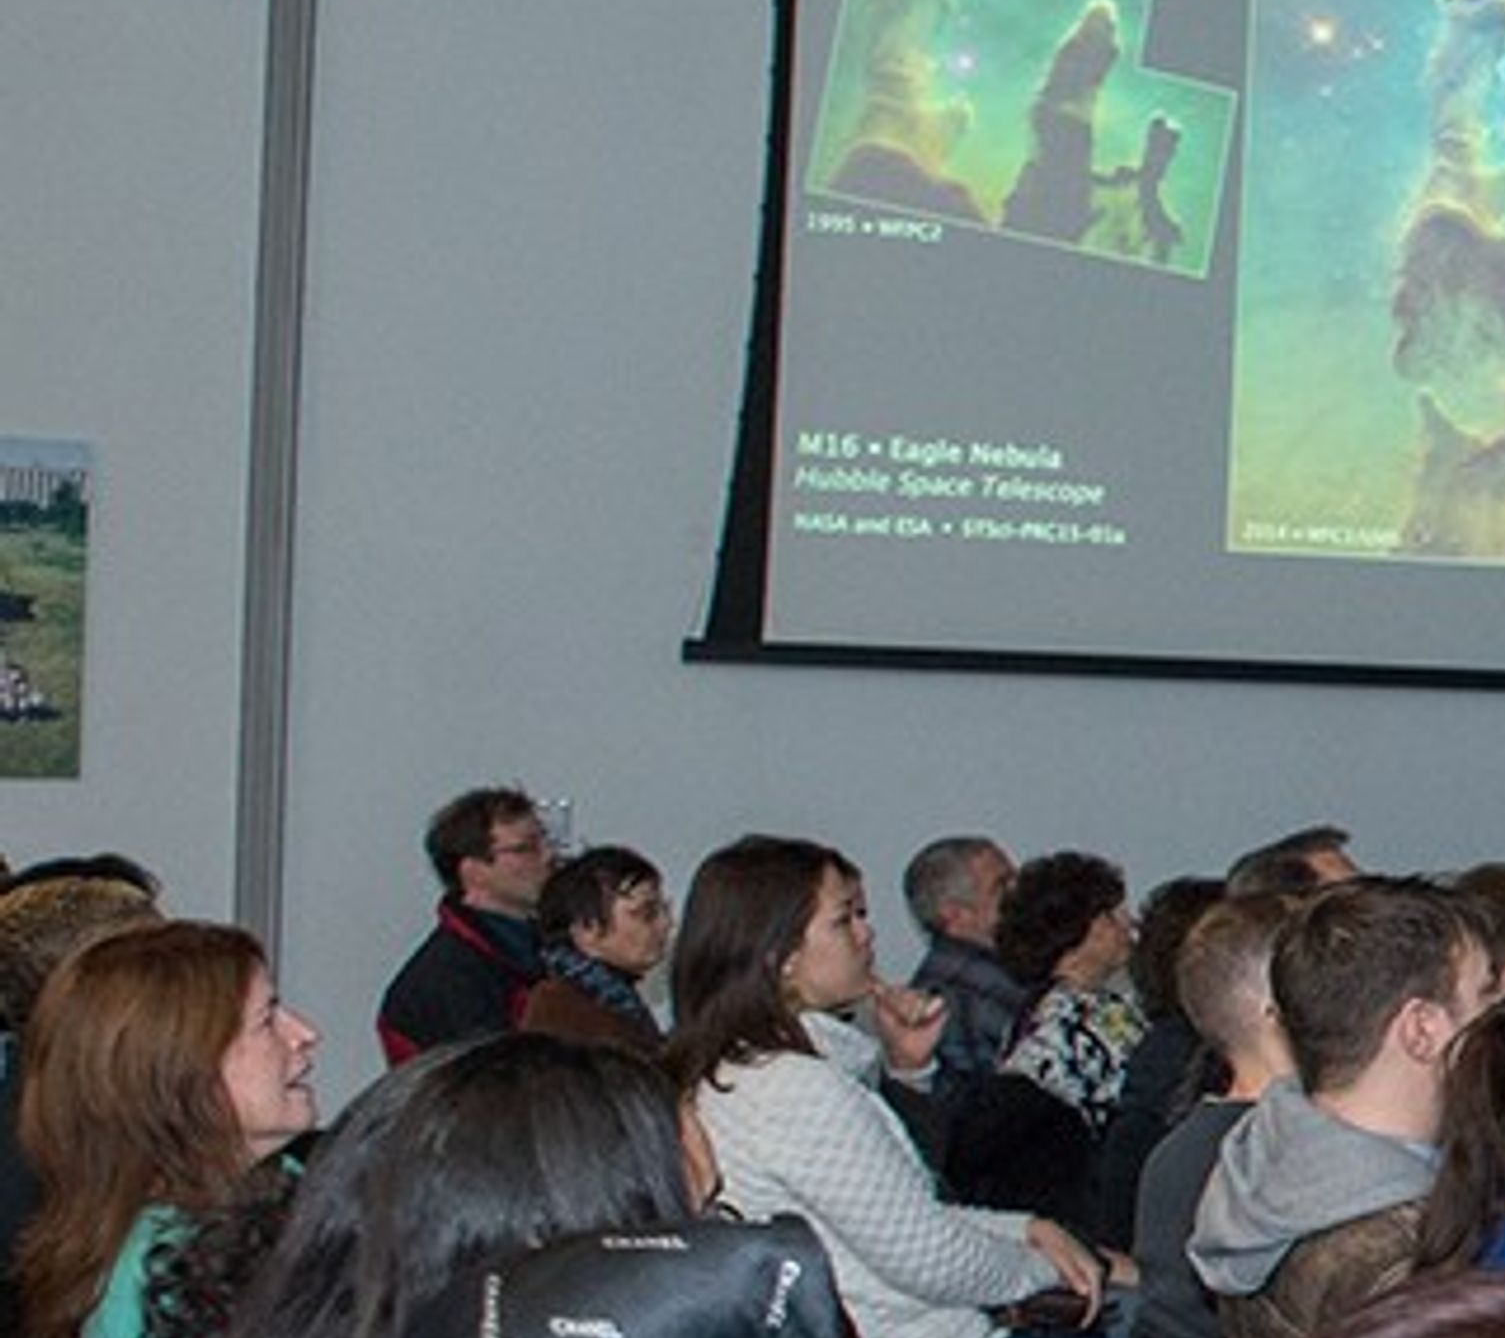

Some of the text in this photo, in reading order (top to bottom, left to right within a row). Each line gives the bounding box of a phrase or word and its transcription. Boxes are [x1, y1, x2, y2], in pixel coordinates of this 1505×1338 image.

[797, 431, 1063, 469] M16 Eagle Nebula
[794, 466, 1105, 507] Hubble Space Telescope
[794, 513, 848, 533] NASA
